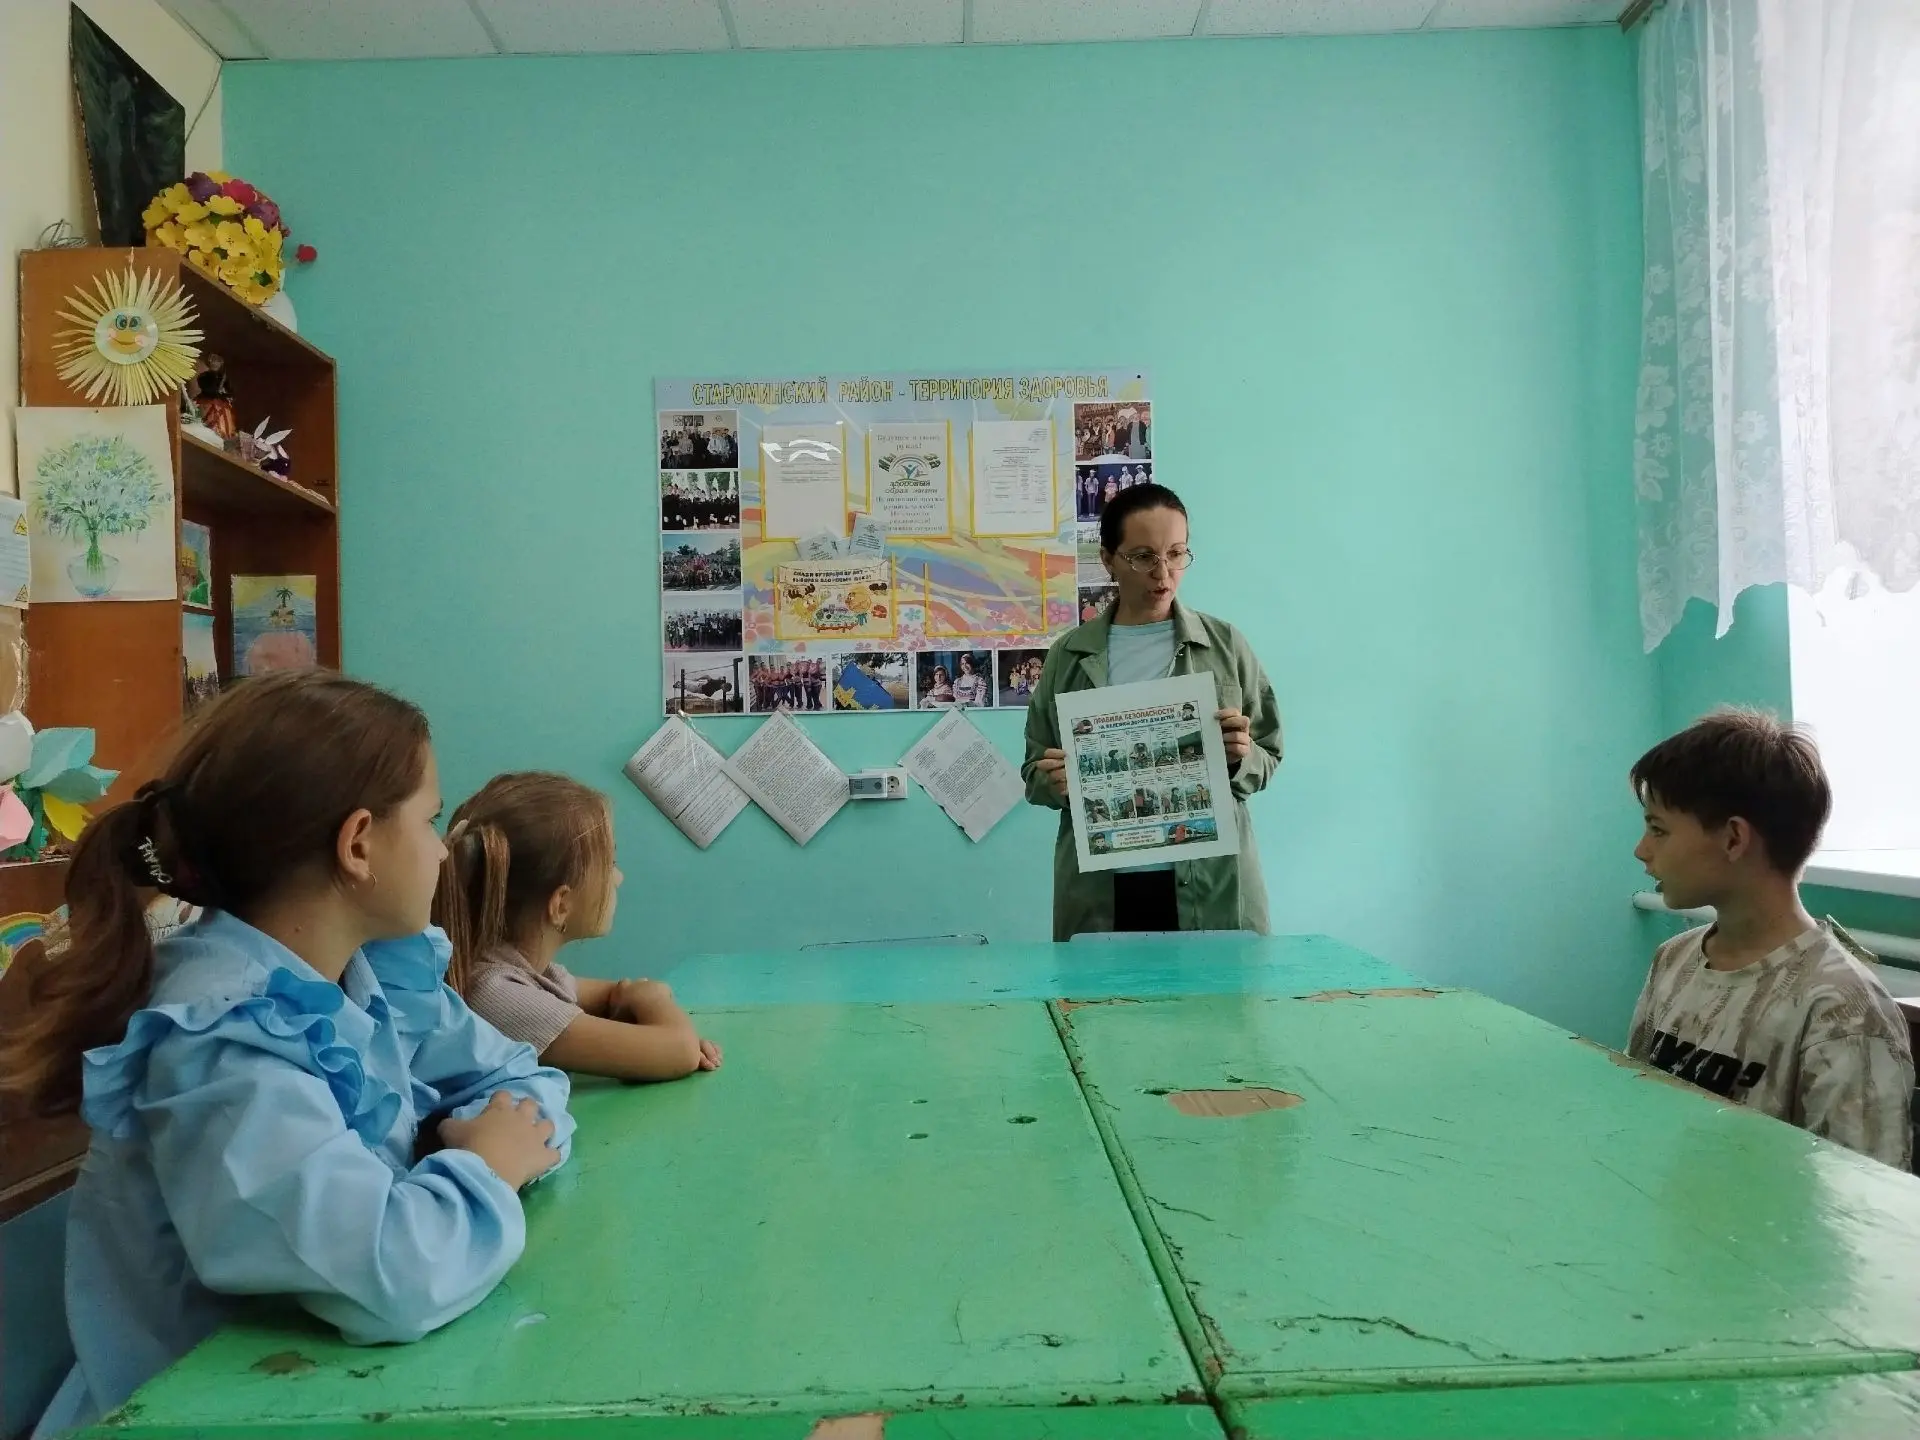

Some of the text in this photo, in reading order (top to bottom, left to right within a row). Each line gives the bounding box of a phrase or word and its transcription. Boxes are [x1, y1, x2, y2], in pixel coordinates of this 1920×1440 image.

[692, 376, 828, 405] СТАРОМИНСКИЙ
[838, 376, 894, 403] РАЙОН
[909, 378, 1014, 402] ТЕРРИТОРИЯ
[1019, 376, 1109, 403] ЗДОРОВЬЯ
[1093, 707, 1175, 724] ПРАВИЛА БЕЗОПАСНОСТИ
